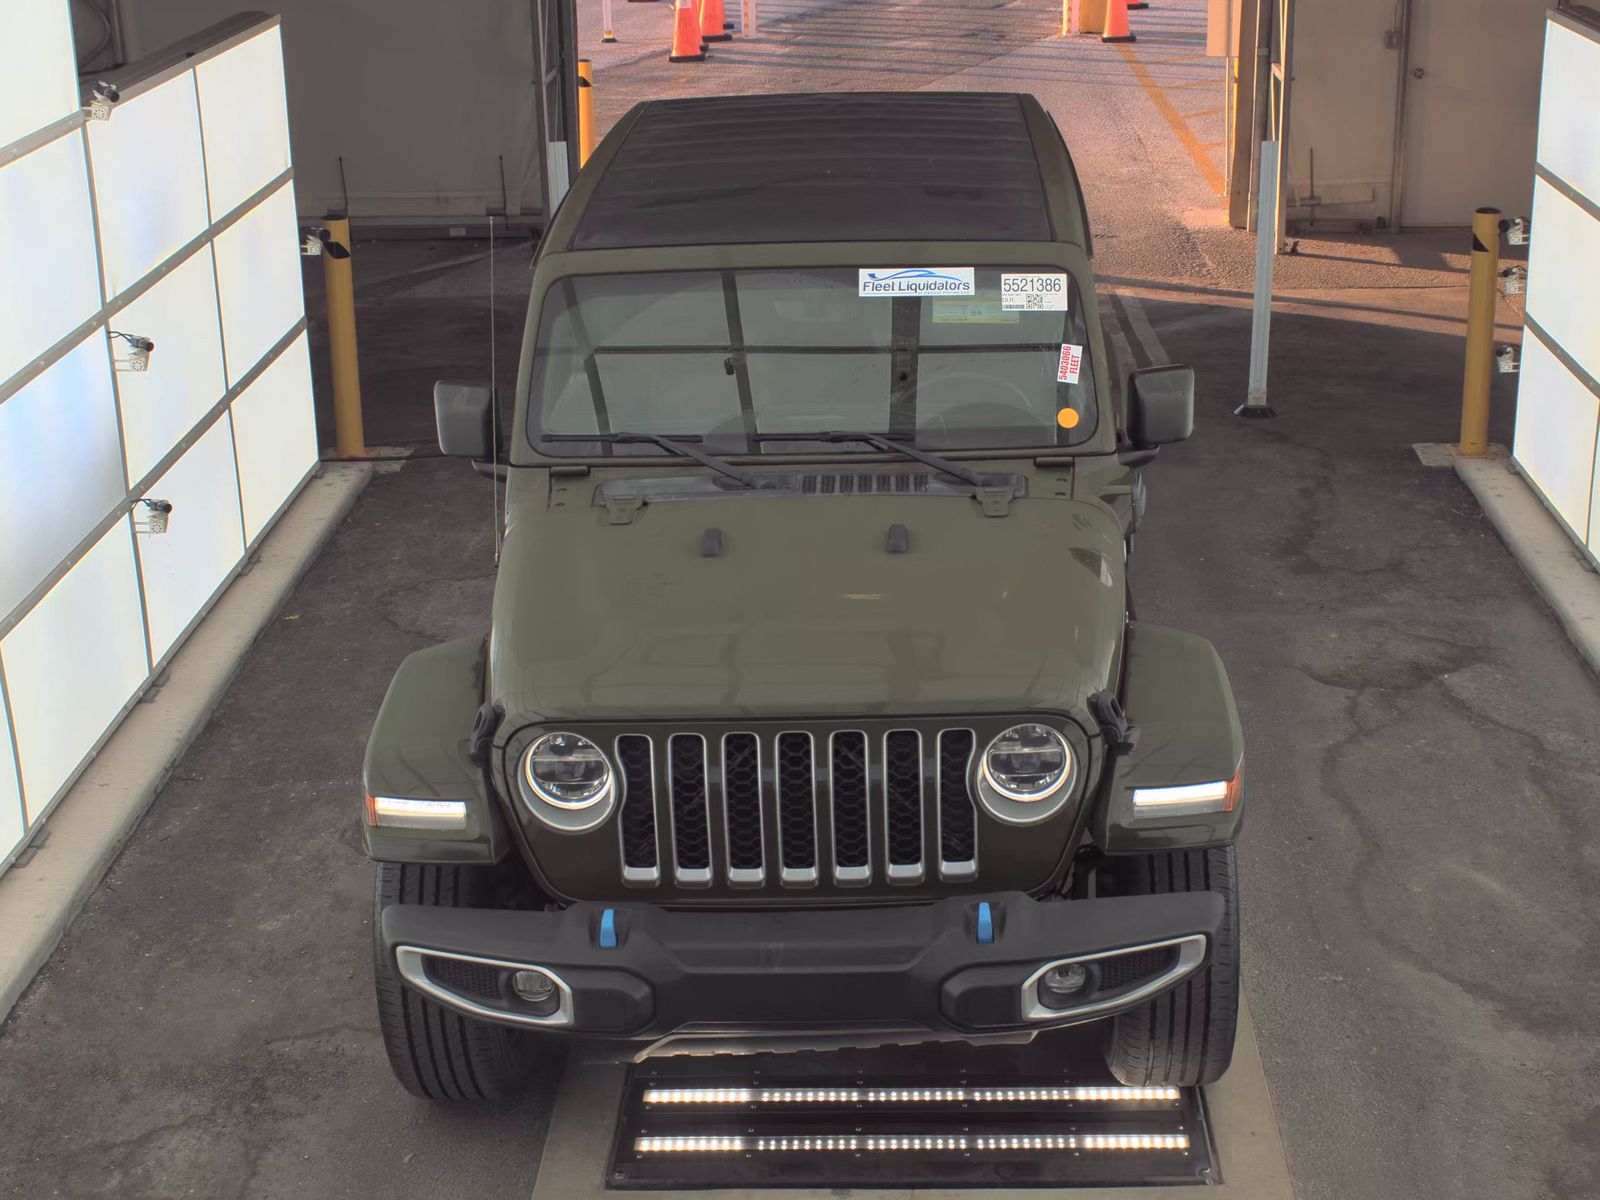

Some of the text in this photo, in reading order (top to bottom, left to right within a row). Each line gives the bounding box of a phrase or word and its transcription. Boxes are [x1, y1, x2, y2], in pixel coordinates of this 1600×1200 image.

[863, 280, 970, 293] Fleet Liquidators
[1003, 277, 1062, 292] 5521386
[1059, 345, 1072, 380] 5403066
[1069, 354, 1080, 375] FLEET
